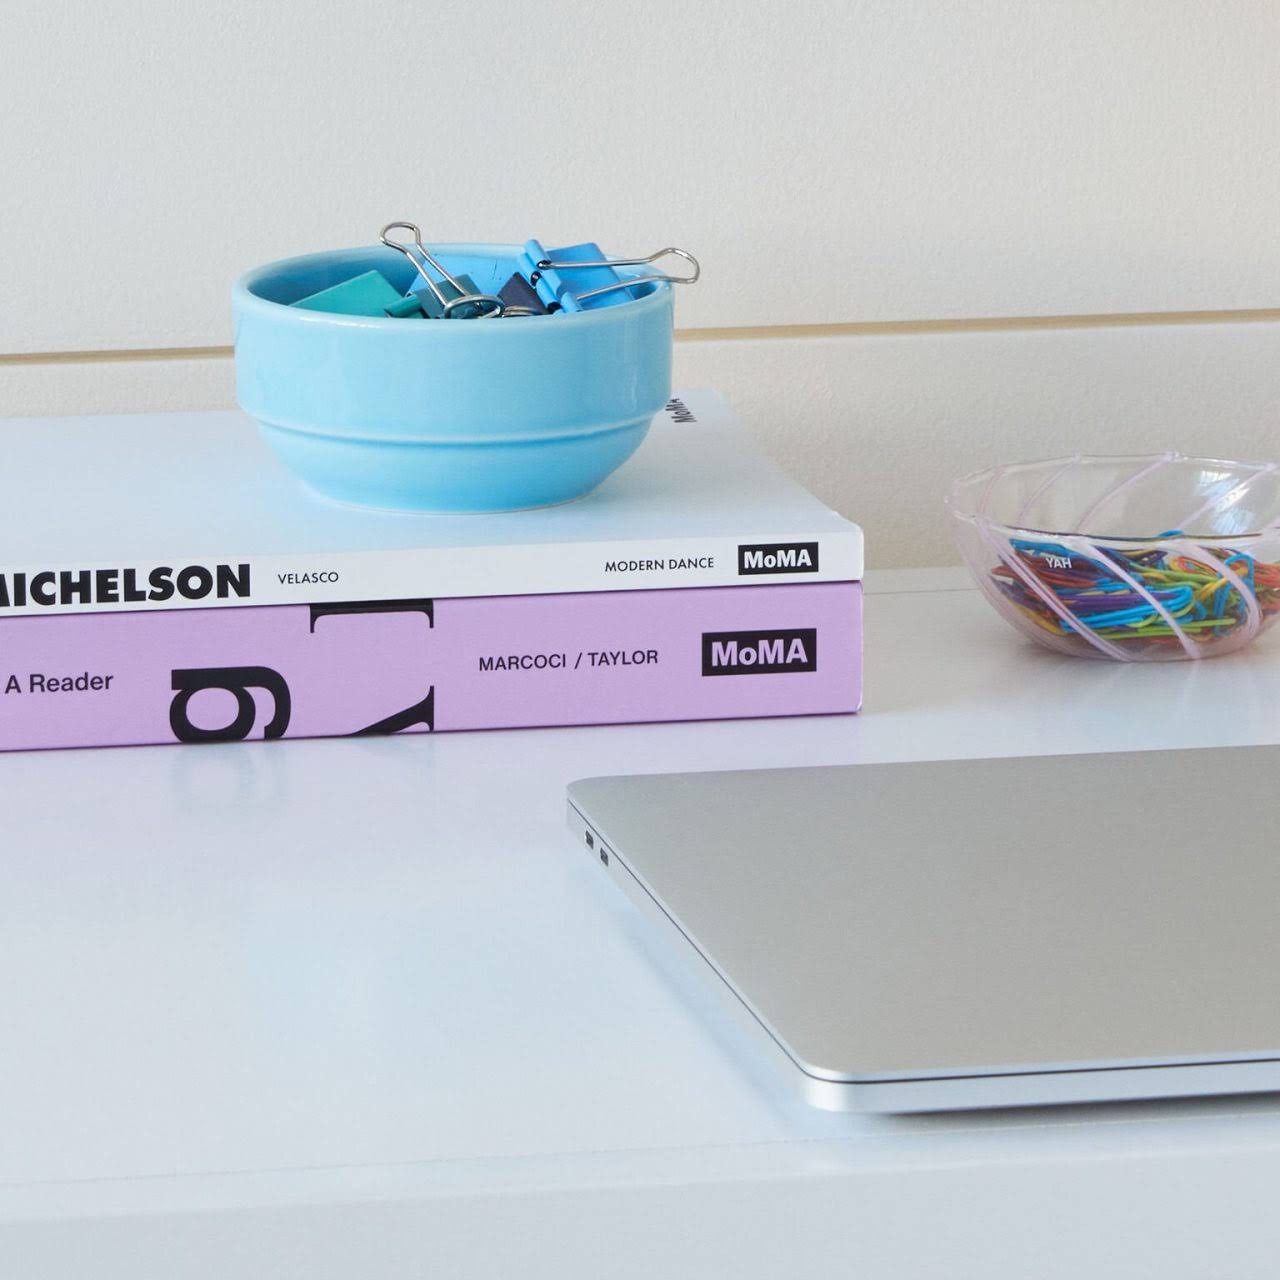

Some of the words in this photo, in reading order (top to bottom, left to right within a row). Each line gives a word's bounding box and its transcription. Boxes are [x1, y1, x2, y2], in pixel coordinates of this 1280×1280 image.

[277, 571, 340, 585] VELASCO
[604, 559, 665, 573] MODERN
[668, 557, 715, 570] DANCE
[743, 548, 812, 569] MoMA
[4, 675, 22, 694] A
[29, 671, 114, 693] Reader
[478, 654, 567, 672] MARCOCI
[588, 650, 659, 667] TAYLOR
[711, 638, 809, 667] MoMA
